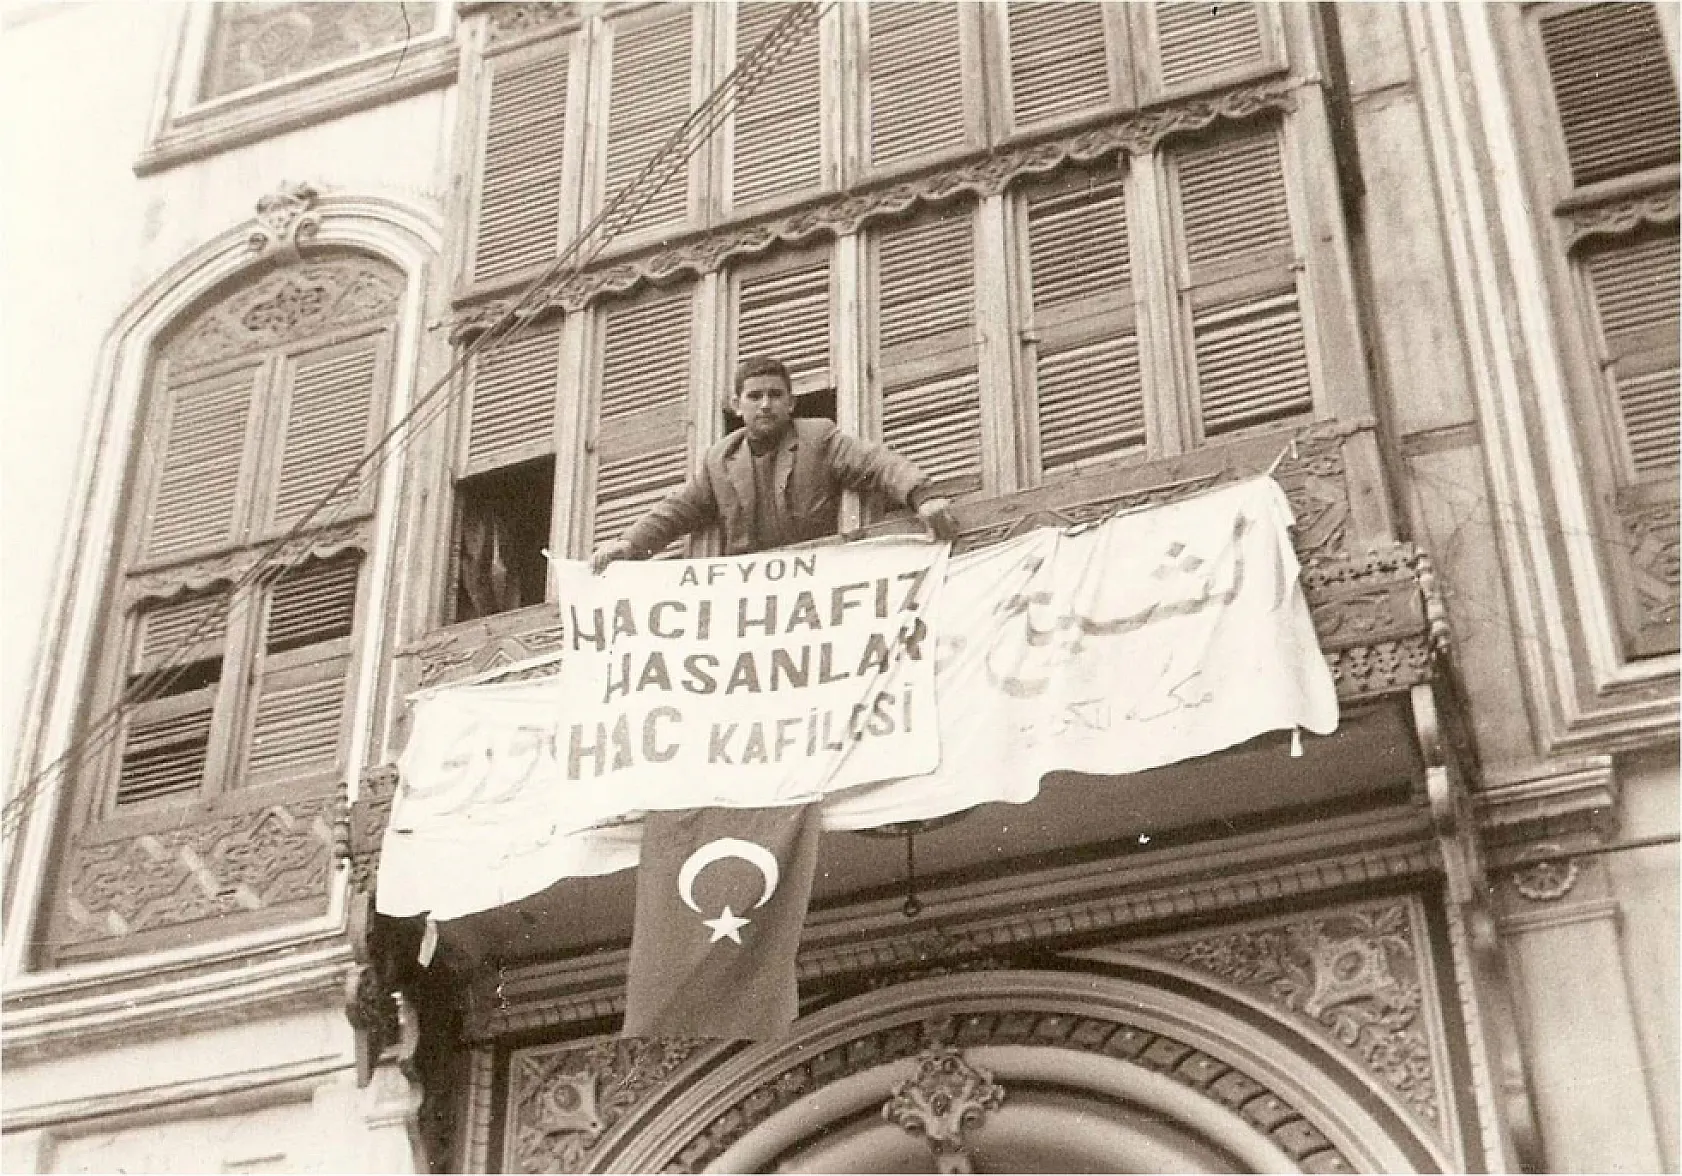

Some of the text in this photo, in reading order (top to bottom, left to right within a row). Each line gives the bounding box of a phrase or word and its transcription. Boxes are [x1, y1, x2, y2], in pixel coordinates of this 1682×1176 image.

[571, 565, 931, 652] HACI HAFIZ
[680, 554, 816, 587] AFYON
[603, 617, 928, 703] HASANLAR
[568, 706, 682, 781] HAC
